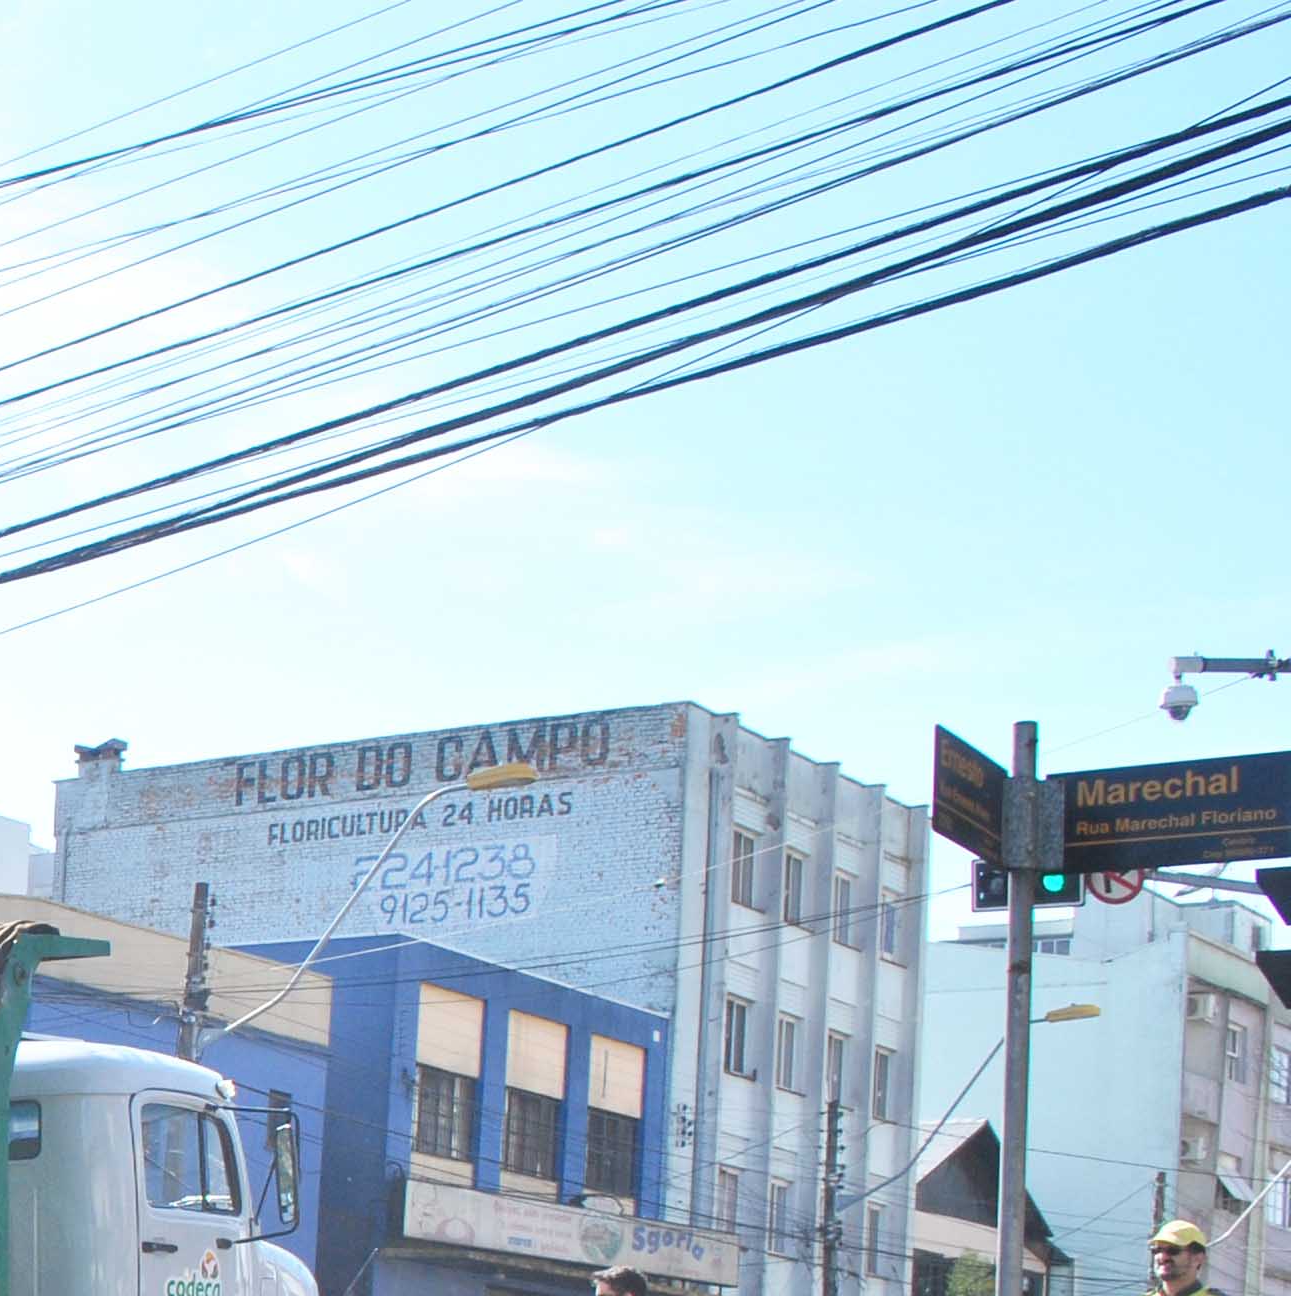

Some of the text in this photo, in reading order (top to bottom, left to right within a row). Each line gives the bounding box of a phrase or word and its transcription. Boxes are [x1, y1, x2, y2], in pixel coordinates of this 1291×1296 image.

[235, 718, 611, 807] FLOR DO CAMPO
[1077, 765, 1240, 808] Marechal
[267, 791, 573, 846] FLORICULTURA 24 HORAS
[1076, 808, 1278, 836] Rua Marechal Floriano
[379, 883, 531, 926] 9125-1135
[631, 1225, 705, 1262] Sgoria
